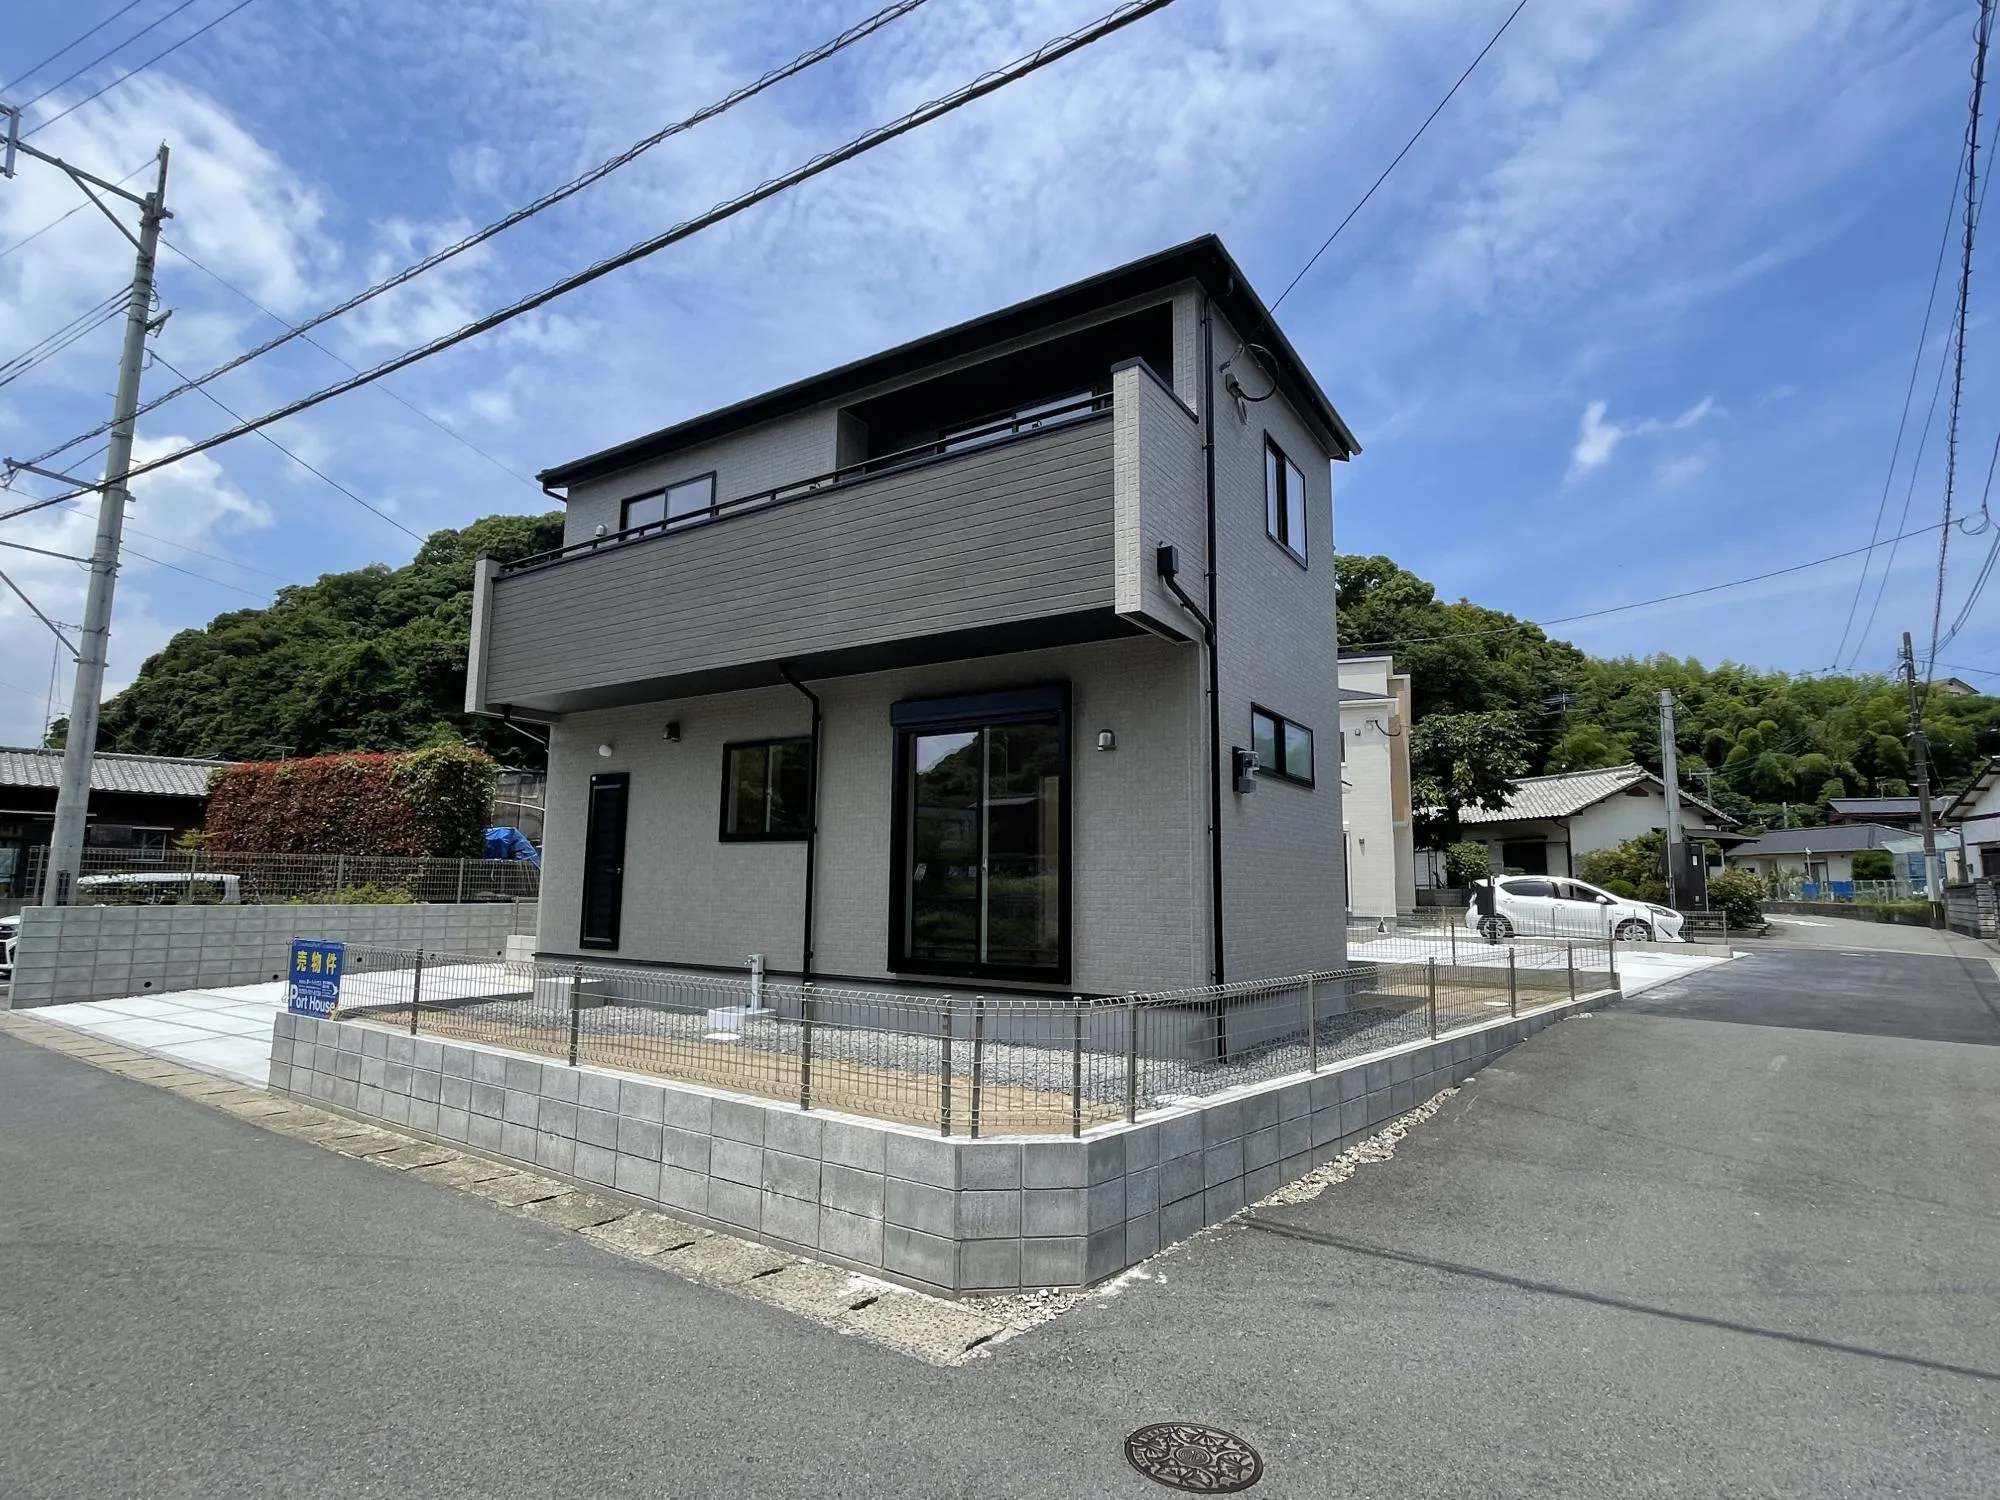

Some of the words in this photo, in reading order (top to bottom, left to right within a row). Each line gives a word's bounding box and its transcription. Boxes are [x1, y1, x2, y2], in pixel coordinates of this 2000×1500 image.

[297, 950, 337, 975] 売物件
[289, 984, 308, 1009] Port
[309, 996, 336, 1013] House
